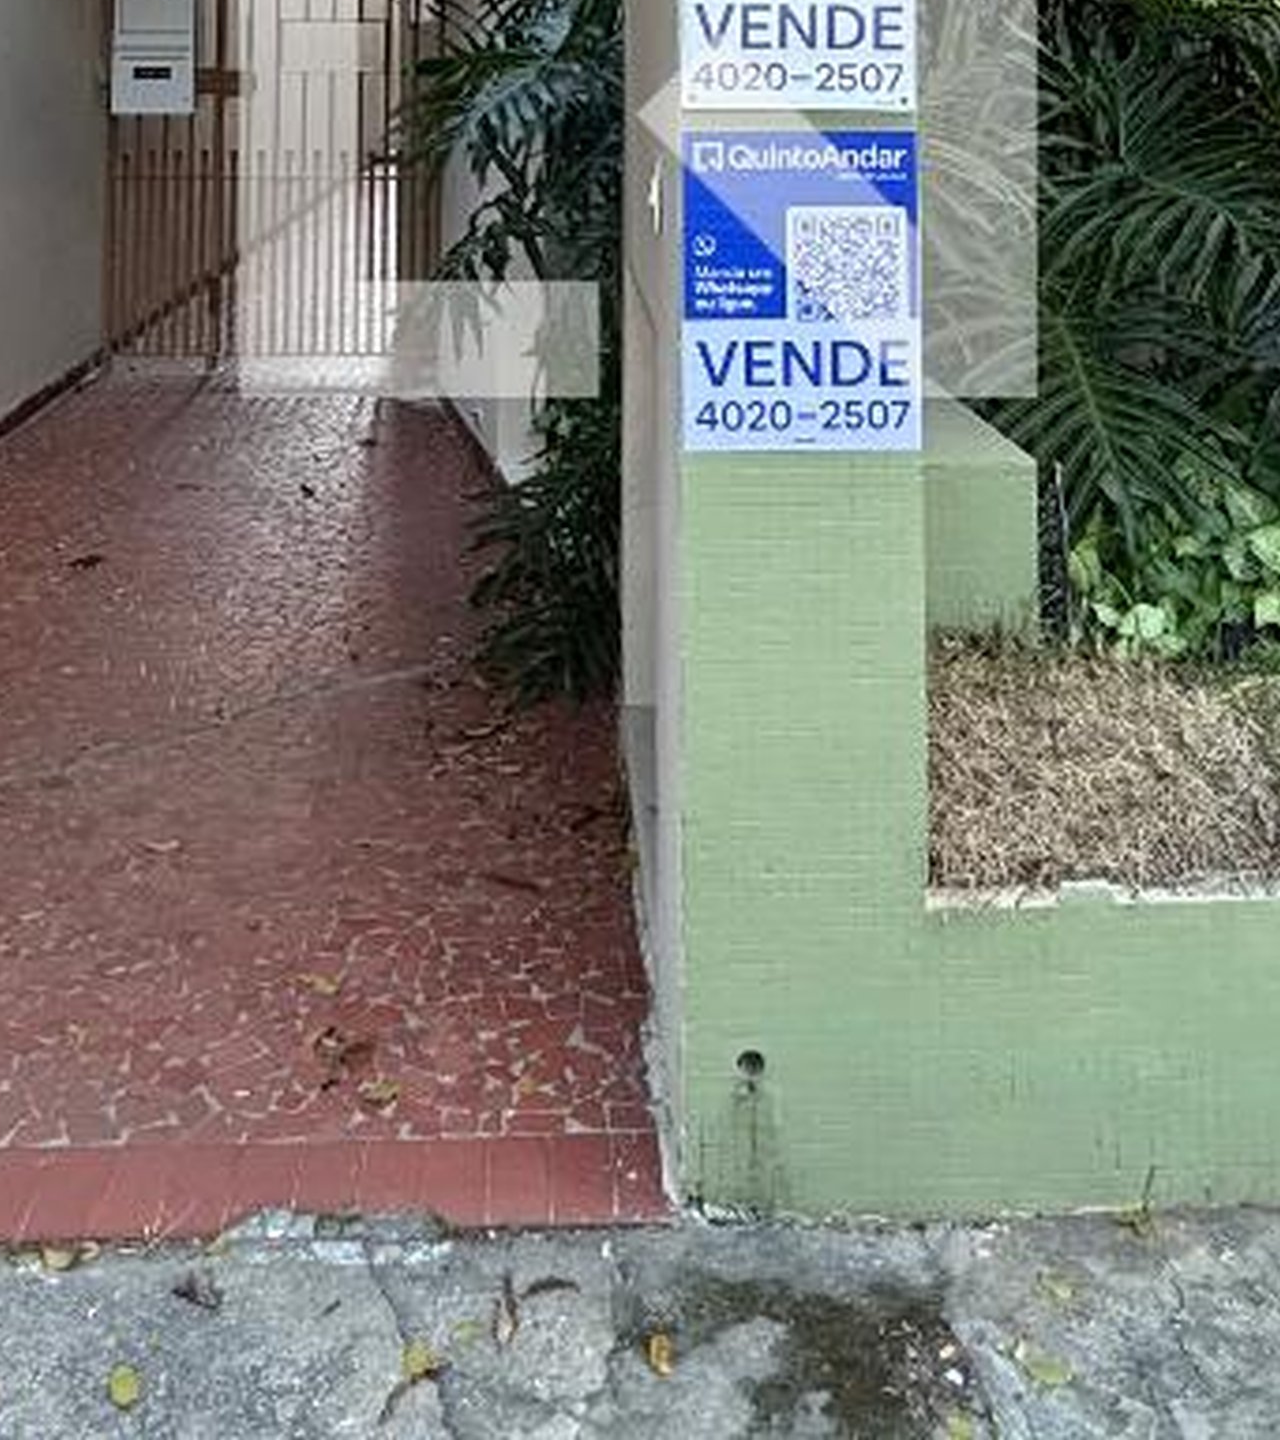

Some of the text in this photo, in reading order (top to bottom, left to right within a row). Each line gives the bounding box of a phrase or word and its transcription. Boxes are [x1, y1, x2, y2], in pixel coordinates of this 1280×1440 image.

[695, 3, 904, 50] VENDE
[692, 62, 904, 93] 4020-2507
[727, 143, 908, 170] QuintoAndar
[695, 340, 910, 387] VENDE
[695, 400, 911, 432] 4020-2507
